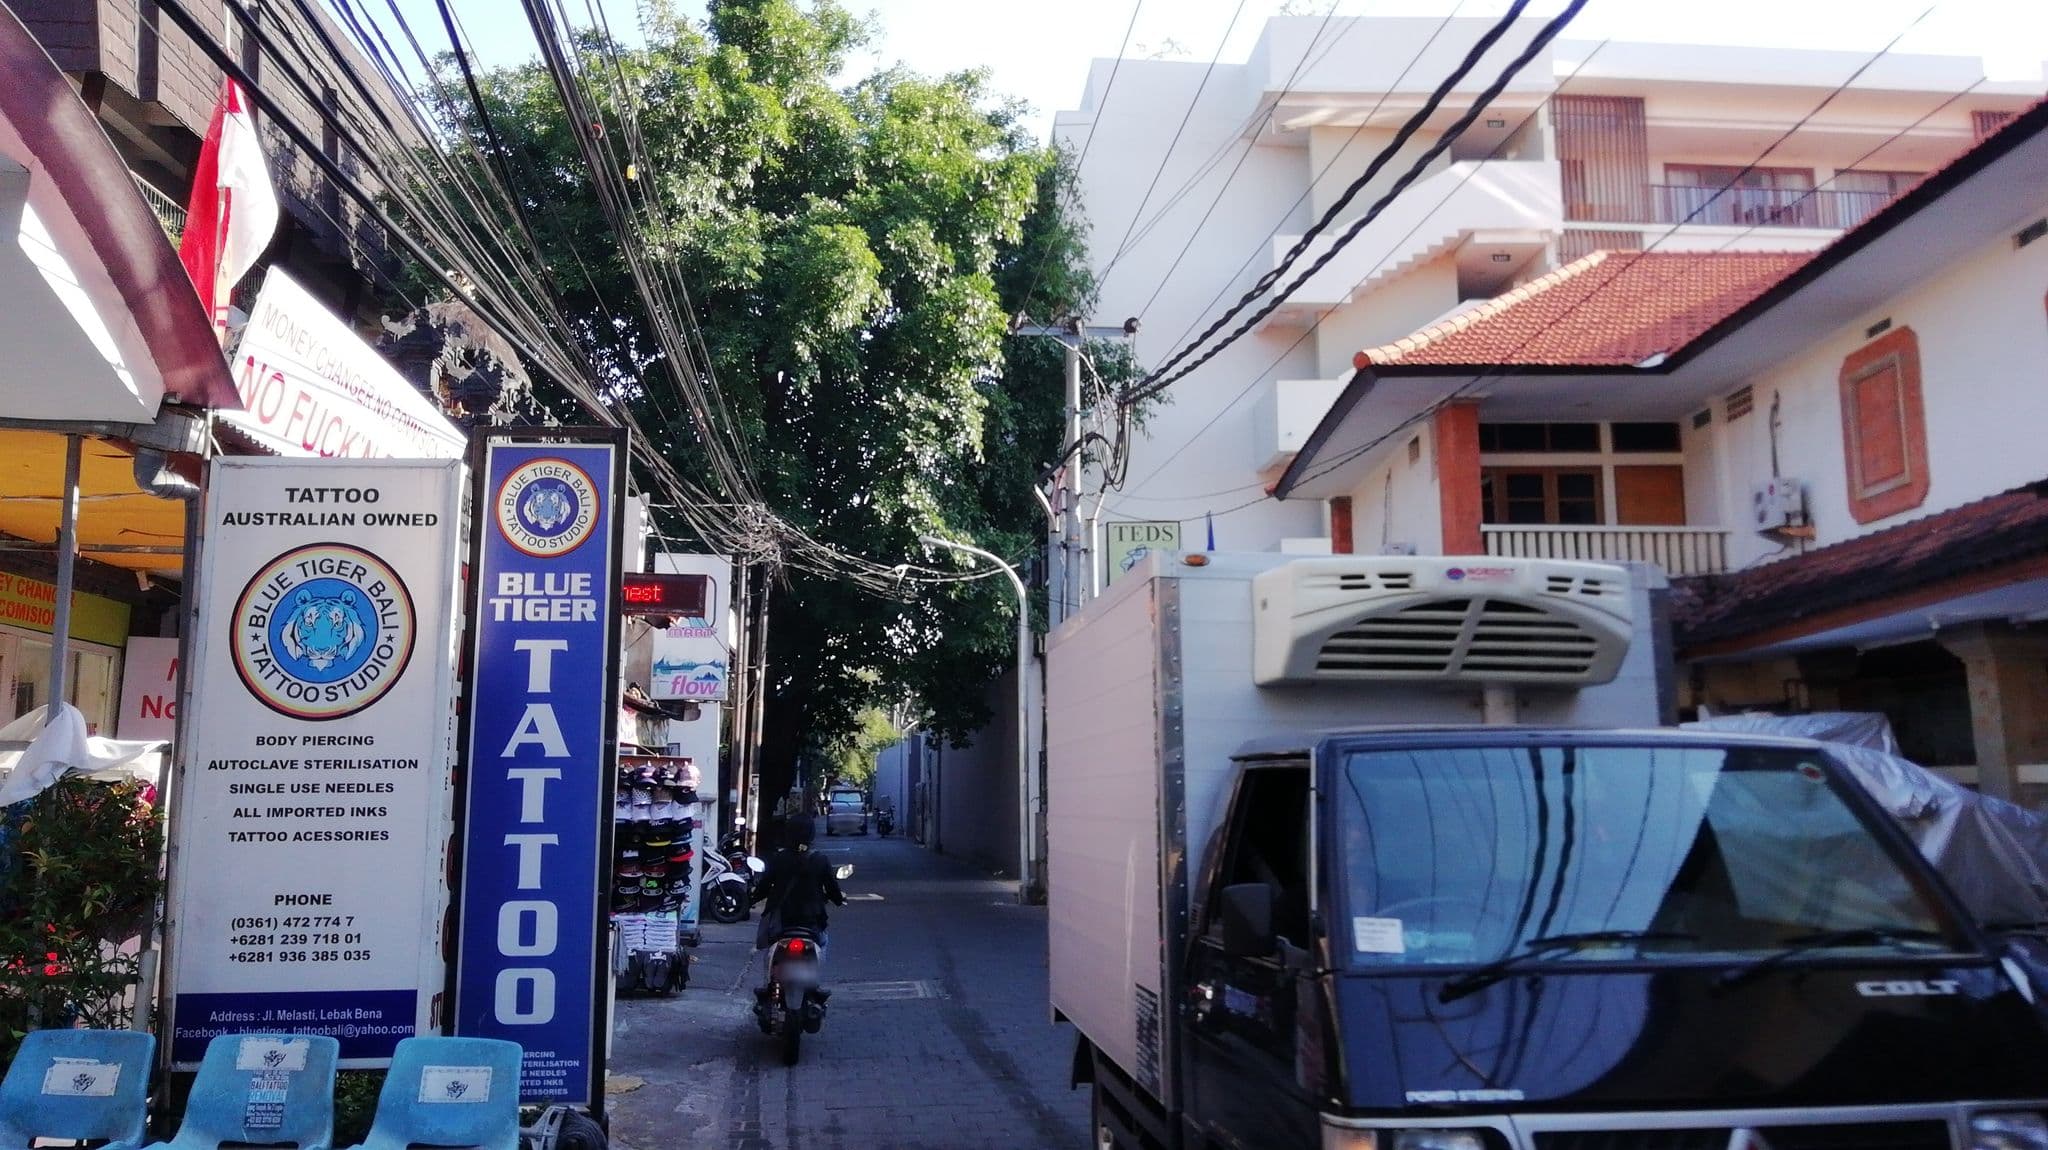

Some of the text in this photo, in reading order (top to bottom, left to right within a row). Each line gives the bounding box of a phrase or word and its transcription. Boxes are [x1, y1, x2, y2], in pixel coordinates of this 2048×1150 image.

[261, 302, 316, 359] MONEY
[238, 355, 285, 424] NO
[505, 466, 591, 507] BLUE TIGER BALI
[285, 487, 380, 503] TATTOO
[222, 512, 438, 527] AUSTRALIAN OWNED
[506, 514, 546, 548] TATTOO
[549, 514, 588, 548] STUDIO
[1113, 525, 1174, 542] TEDS
[498, 572, 591, 595] BLUE
[248, 558, 399, 629] BLUE TIGER BALI
[489, 598, 597, 621] TIGER
[251, 643, 394, 703] TATTOO STUDIO
[670, 674, 719, 695] flow
[256, 735, 375, 746] BODY PIERCING
[208, 758, 418, 771] AUTOCLAVE STERILISATION
[229, 782, 394, 794] SINGLE USE NEEDLES
[233, 806, 387, 818] ALL IMPORTED INKS
[228, 830, 390, 843] TATTOO ACESSORIES
[494, 640, 571, 1025] TATTOO
[274, 894, 332, 906] PHONE
[231, 916, 355, 931] (0361) 472 774 7
[230, 933, 362, 945] +6281 239 718 01
[229, 950, 371, 962] +6281 936 385 035
[1856, 980, 1961, 996] COLT
[209, 1010, 255, 1022] Address
[262, 1009, 275, 1021] Jl.
[276, 1009, 318, 1021] Melasti,
[320, 1008, 353, 1020] Lebak
[355, 1008, 383, 1019] Bena
[175, 1027, 228, 1038] Facebook
